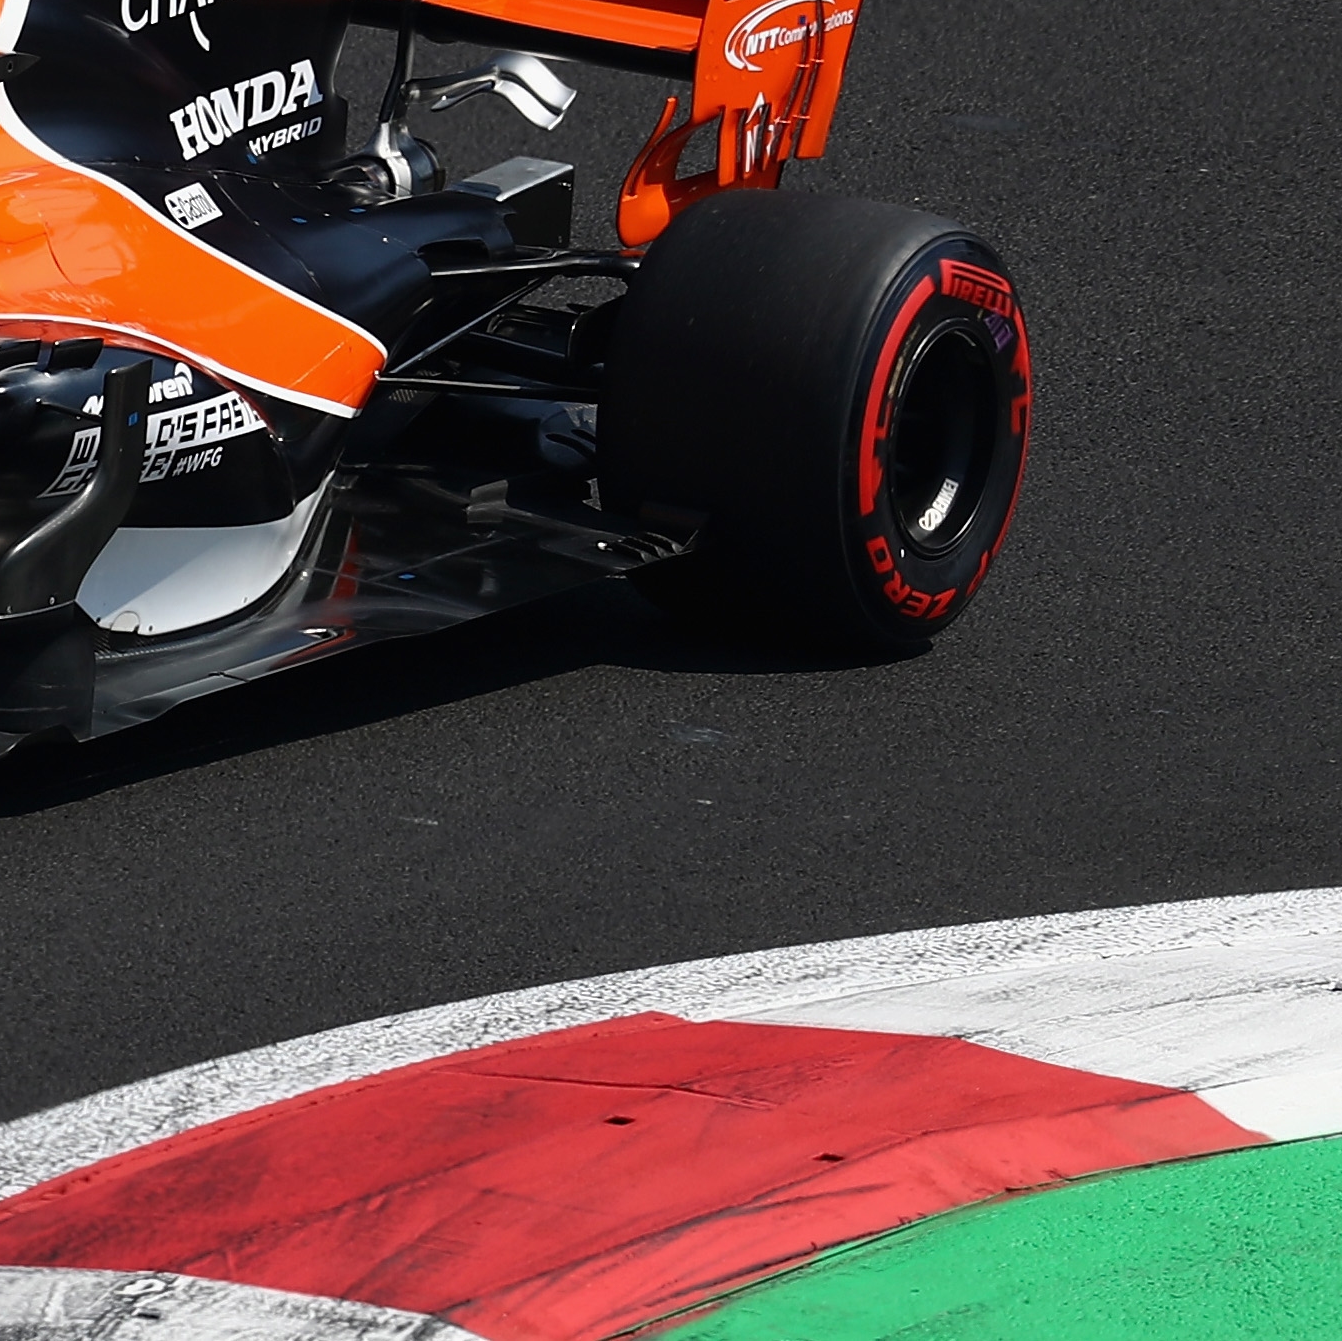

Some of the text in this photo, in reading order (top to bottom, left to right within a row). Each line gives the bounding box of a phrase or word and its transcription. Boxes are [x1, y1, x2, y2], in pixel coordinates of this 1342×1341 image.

[745, 26, 781, 57] NTT
[169, 59, 323, 161] HONDA
[249, 117, 323, 157] HYBRID
[939, 257, 1013, 319] PIRELLI
[171, 446, 224, 477] #WFG
[865, 535, 957, 620] ZERO
